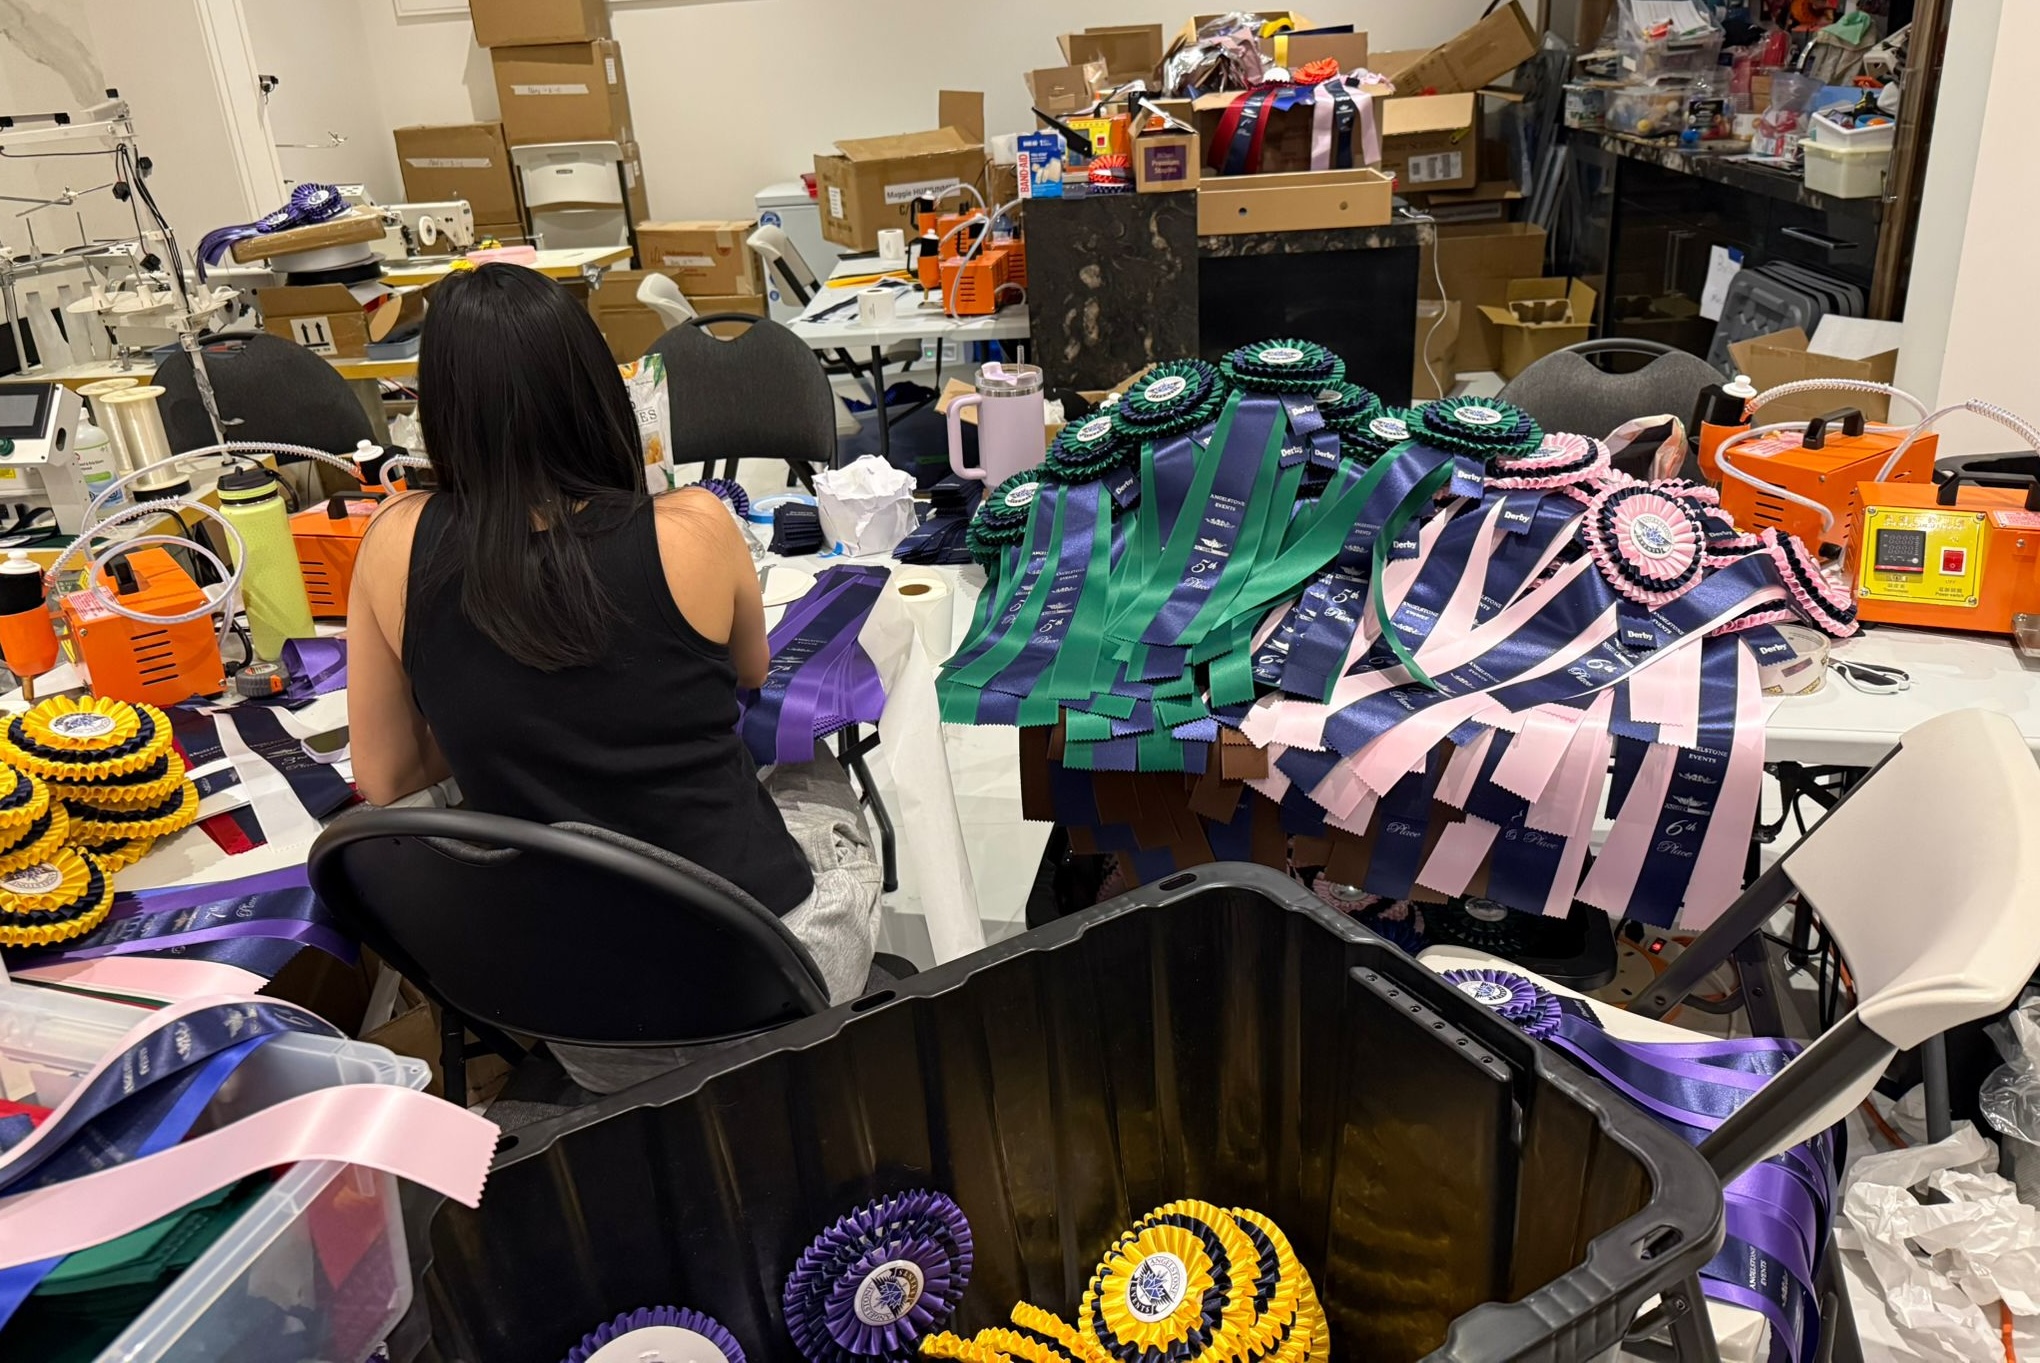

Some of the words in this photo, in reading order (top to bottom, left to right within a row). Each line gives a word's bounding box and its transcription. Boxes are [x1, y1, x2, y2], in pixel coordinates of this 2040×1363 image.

[1018, 153, 1030, 193] BAND-AID
[887, 189, 915, 200] Maggie
[1292, 404, 1315, 416] Derby
[1280, 446, 1304, 457] Derby
[1314, 449, 1337, 461] Derby
[1457, 470, 1481, 482] Derby
[1115, 477, 1134, 495] Derby
[1504, 511, 1530, 523] Derby
[1393, 540, 1417, 549] Derby
[1190, 559, 1218, 573] 5th
[1332, 588, 1360, 603] 5th
[1039, 618, 1065, 633] 5th
[1627, 630, 1654, 641] Derby
[1760, 643, 1788, 655] Derby
[1688, 753, 1717, 763] EVENTS
[1386, 821, 1422, 839] Place
[1665, 820, 1698, 836] 6th
[1522, 831, 1558, 850] Place
[1656, 840, 1693, 858] Place
[1748, 1245, 1758, 1290] ANGELSTONE
[1760, 1259, 1768, 1287] EVENTS
